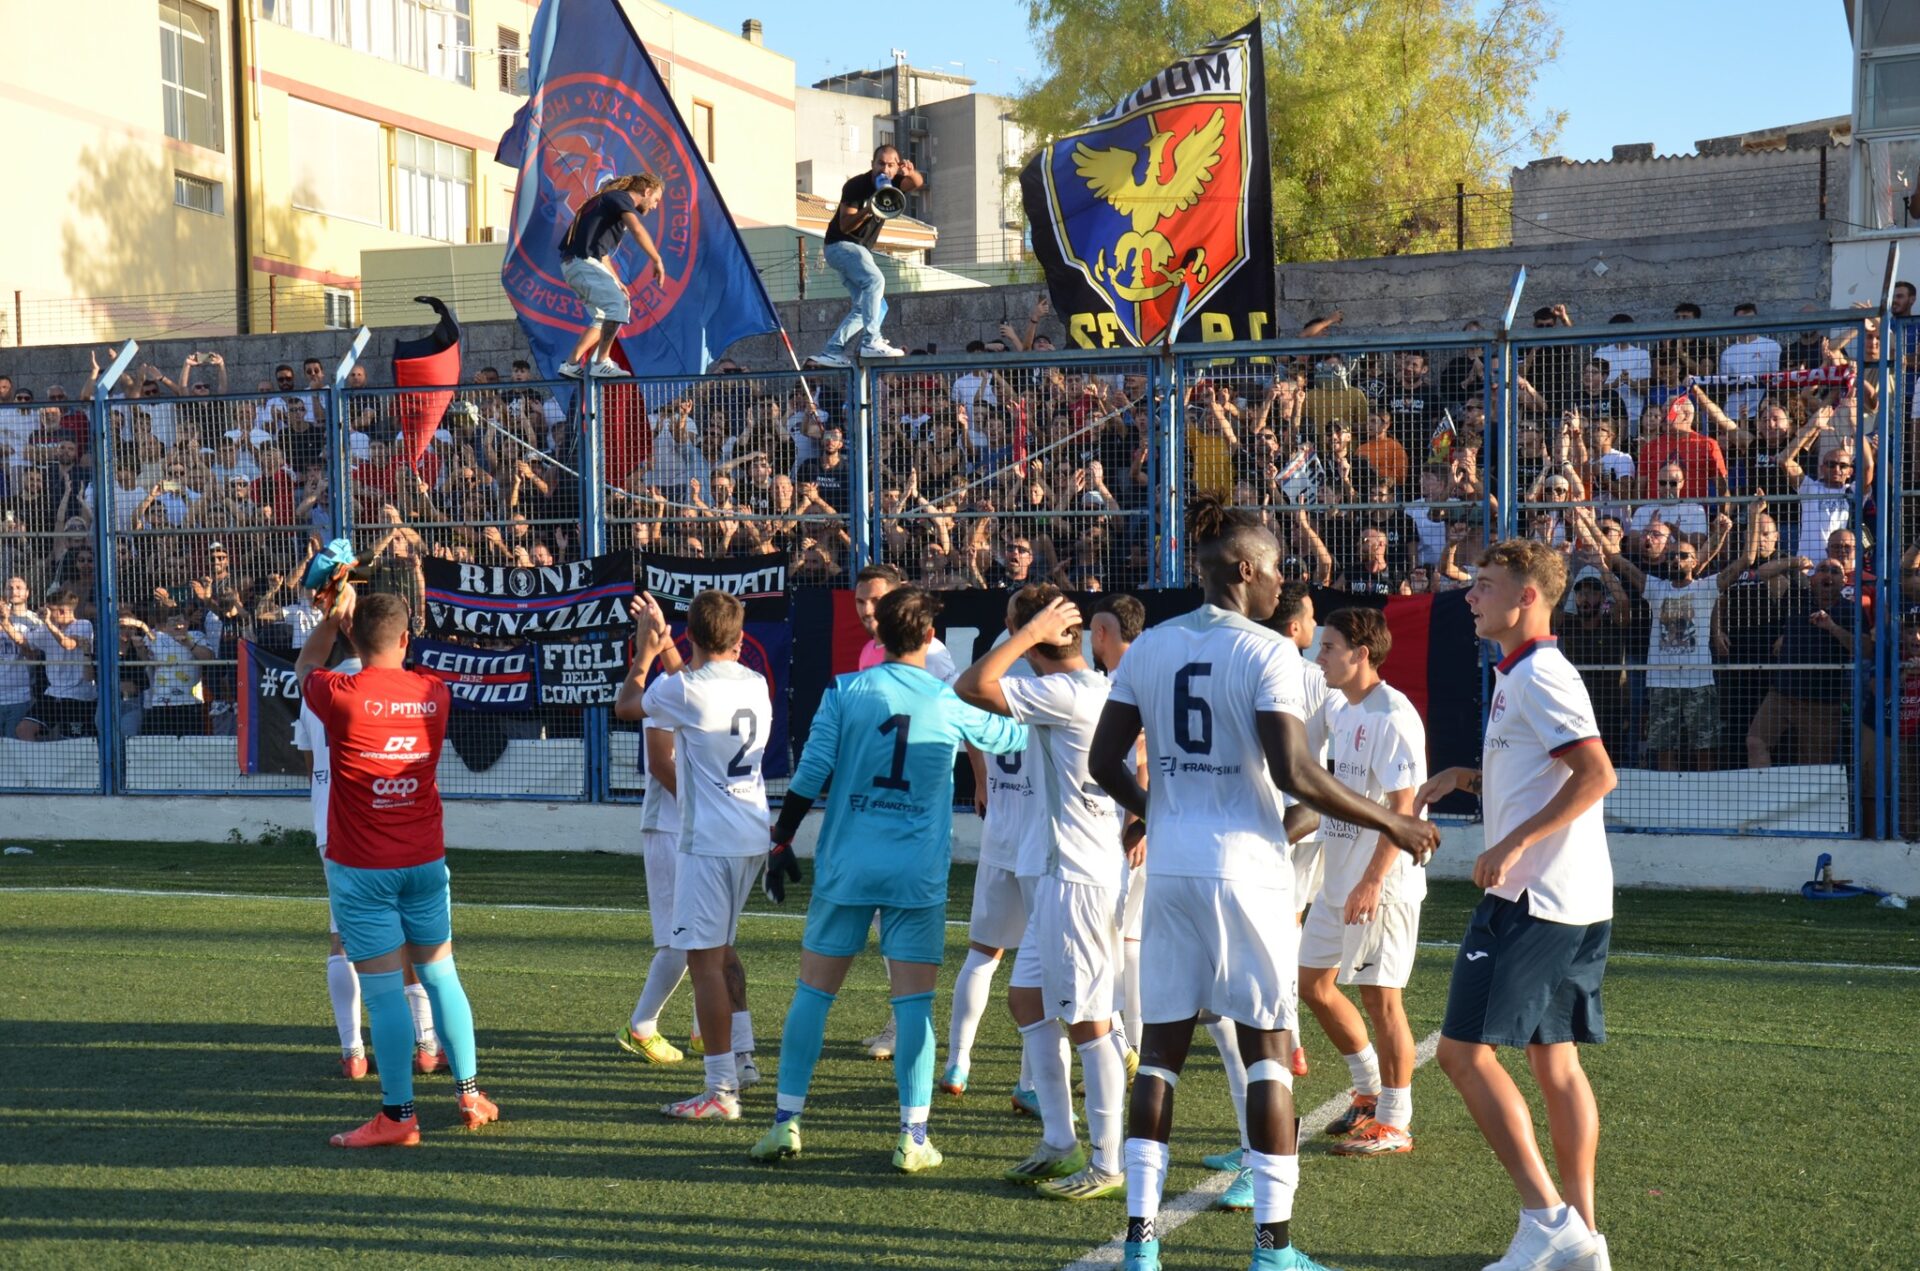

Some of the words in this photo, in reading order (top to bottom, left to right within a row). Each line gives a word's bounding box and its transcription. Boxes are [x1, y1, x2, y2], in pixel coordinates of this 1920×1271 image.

[458, 560, 594, 597] RIONE
[646, 565, 785, 598] DIFFIDATI
[427, 597, 632, 636] VIGNAZZA
[542, 640, 624, 671] FIGLI
[561, 671, 607, 685] DELLA
[390, 701, 438, 715] PITINO
[1173, 662, 1213, 756] 6
[383, 736, 418, 752] DR
[727, 708, 757, 777] 2
[872, 713, 911, 792] 1
[372, 778, 419, 798] coop
